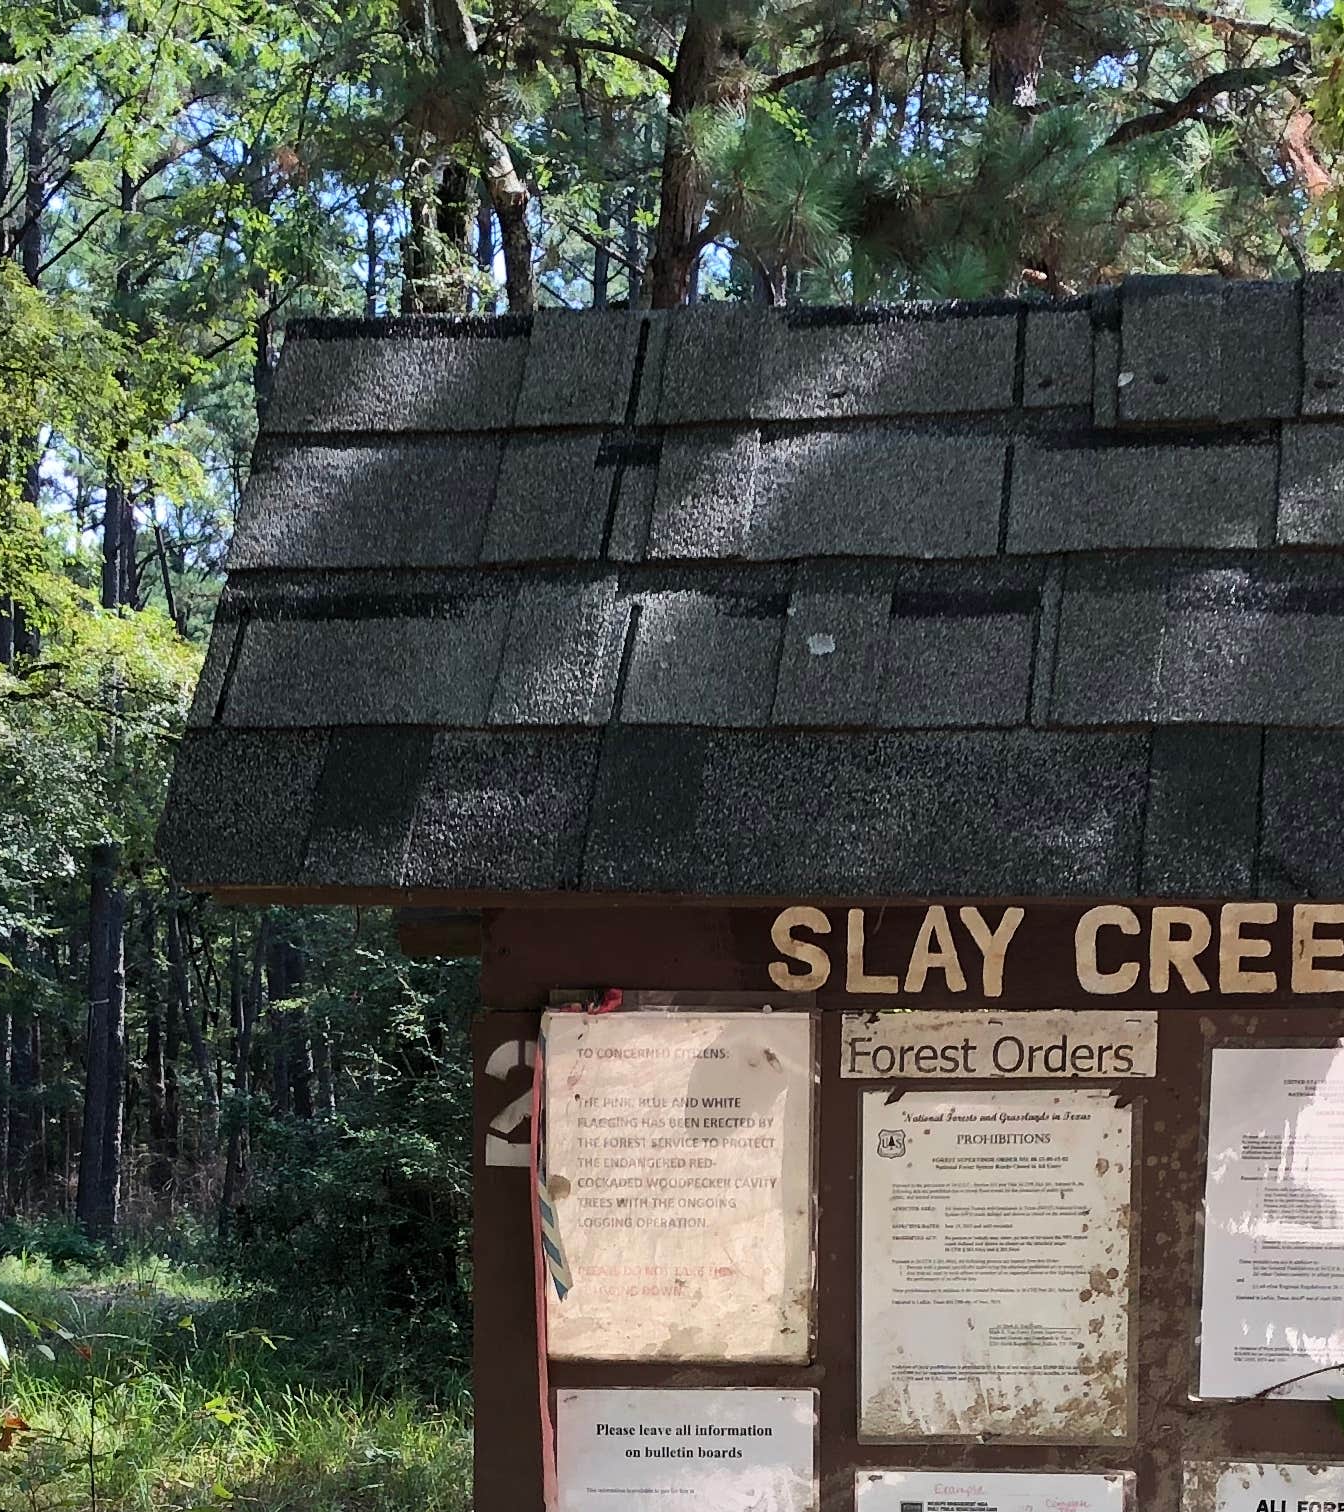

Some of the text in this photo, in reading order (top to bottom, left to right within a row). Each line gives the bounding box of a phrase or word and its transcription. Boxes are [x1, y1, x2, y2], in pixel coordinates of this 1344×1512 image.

[767, 906, 1025, 997] SLAY
[578, 1048, 593, 1059] TO
[848, 1034, 1135, 1074] Forest Orders
[673, 1097, 699, 1109] AND
[702, 1097, 741, 1109] WHITE
[578, 1117, 774, 1129] FLAGGING HAS BEEN ERECTED BY
[904, 1112, 1091, 1124] National Forests and Grasslands in Texas
[578, 1137, 776, 1149] THE FOREST SERVICE TO PROTECT
[956, 1133, 1051, 1145] PROHIBITIONS
[578, 1157, 600, 1169] THE
[603, 1157, 687, 1169] ENDANGERED
[578, 1177, 777, 1190] COCKADED WOODPECKER CAVITY
[578, 1197, 737, 1209] TREES WITH THE ONGOING
[578, 1217, 633, 1229] LOGGING
[596, 1423, 773, 1437] Please leave all information
[625, 1446, 743, 1459] on bulletin boards
